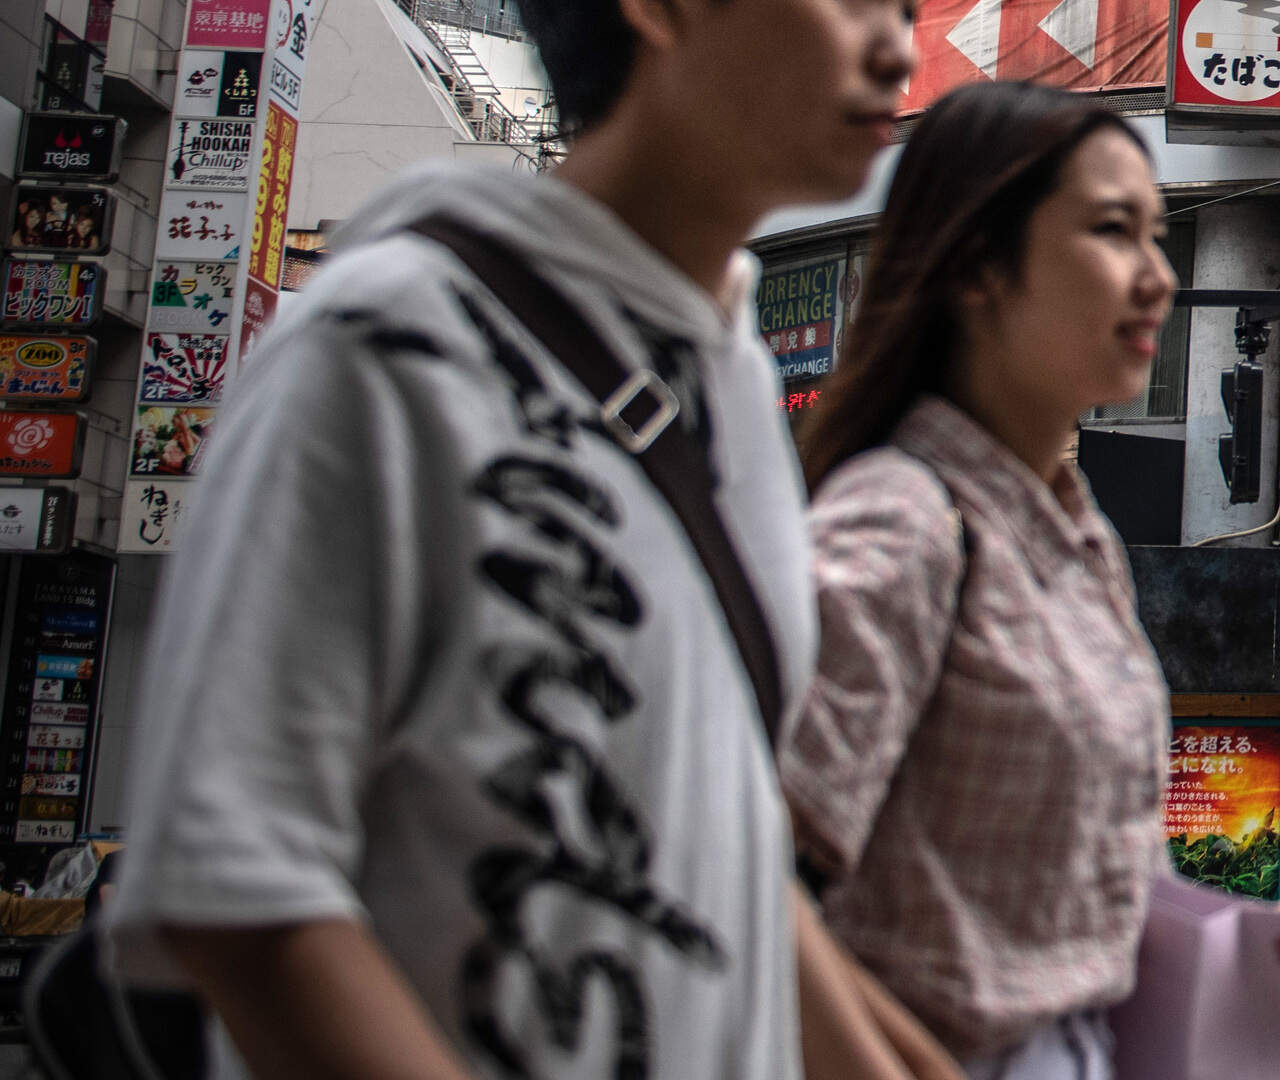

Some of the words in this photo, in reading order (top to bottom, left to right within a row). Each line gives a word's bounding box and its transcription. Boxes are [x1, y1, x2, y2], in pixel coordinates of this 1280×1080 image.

[238, 103, 256, 117] 6F
[199, 121, 252, 138] SHISHA
[190, 135, 251, 153] HOOKAH
[42, 147, 91, 169] rejas
[187, 151, 244, 172] Chillup
[155, 284, 178, 304] 3F
[144, 384, 171, 400] 2F
[135, 457, 161, 473] 2F
[139, 482, 169, 546] ねぎし
